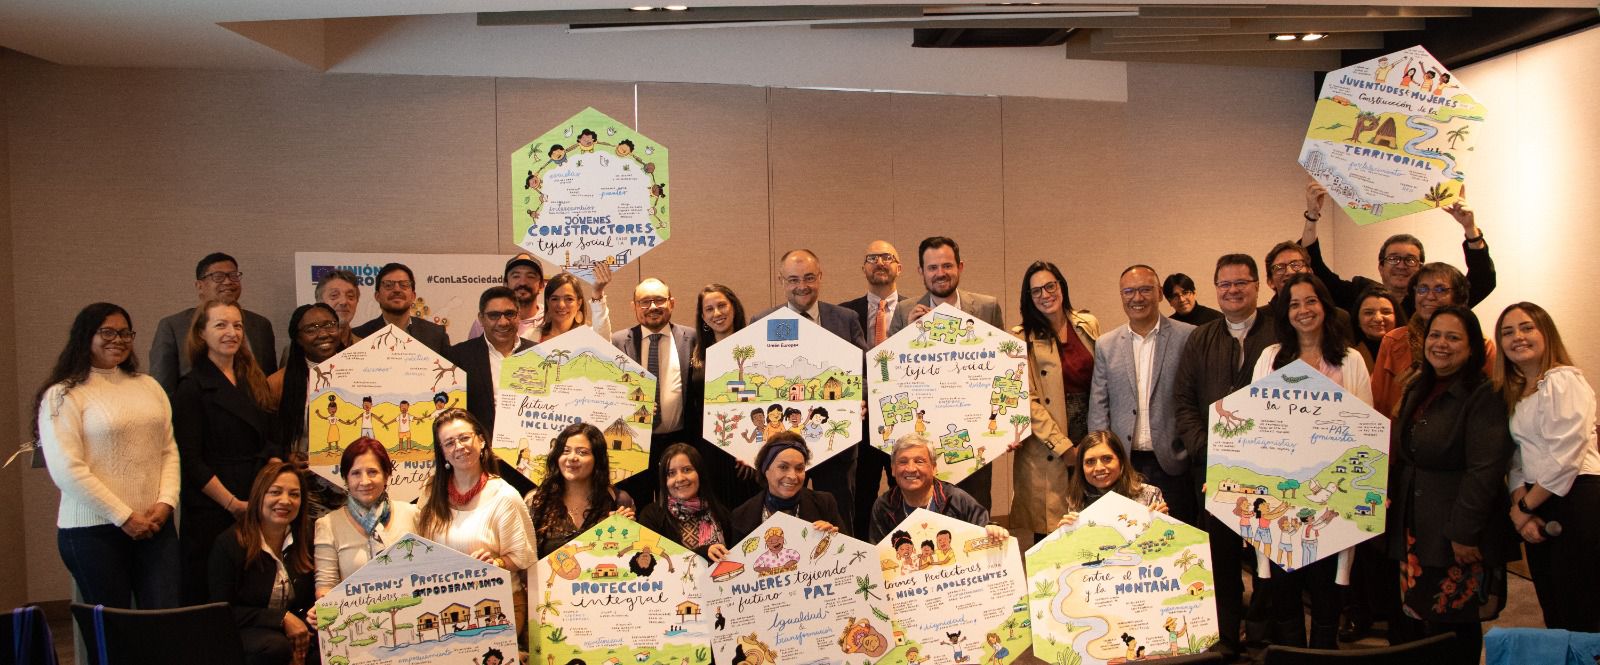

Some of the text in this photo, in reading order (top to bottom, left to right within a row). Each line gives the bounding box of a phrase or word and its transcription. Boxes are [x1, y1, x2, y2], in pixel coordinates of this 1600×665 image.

[1340, 75, 1403, 96] JUVENTUDES
[1411, 91, 1458, 108] MUJERES
[1345, 144, 1432, 170] TERRITORIAL
[565, 214, 611, 224] JÓVENES
[528, 224, 654, 236] CONSTRUCTORES
[538, 239, 573, 255] tejido
[630, 236, 656, 247] PAZ
[427, 276, 505, 284] #ConLaSociedad
[899, 348, 996, 364] RECONSTRUCCIÓN
[903, 364, 941, 380] tejido
[1250, 387, 1342, 402] REACTIVAR
[518, 396, 559, 416] futuro
[1265, 401, 1280, 410] la
[520, 420, 566, 432] INCLUS
[525, 410, 582, 424] ORGÁNICO
[404, 460, 436, 469] MUJE
[345, 568, 488, 597] ENTORNOS PROTECTORES
[572, 578, 664, 596] PROTECCIÓN
[732, 560, 848, 596] MUJERES tejiendo
[896, 586, 928, 600] NIÑOS
[936, 570, 1008, 592] ADOLESCENTES
[1115, 576, 1181, 595] MONTAÑA
[571, 592, 668, 612] integral
[738, 592, 782, 613] futuro
[804, 584, 835, 600] PAZ
